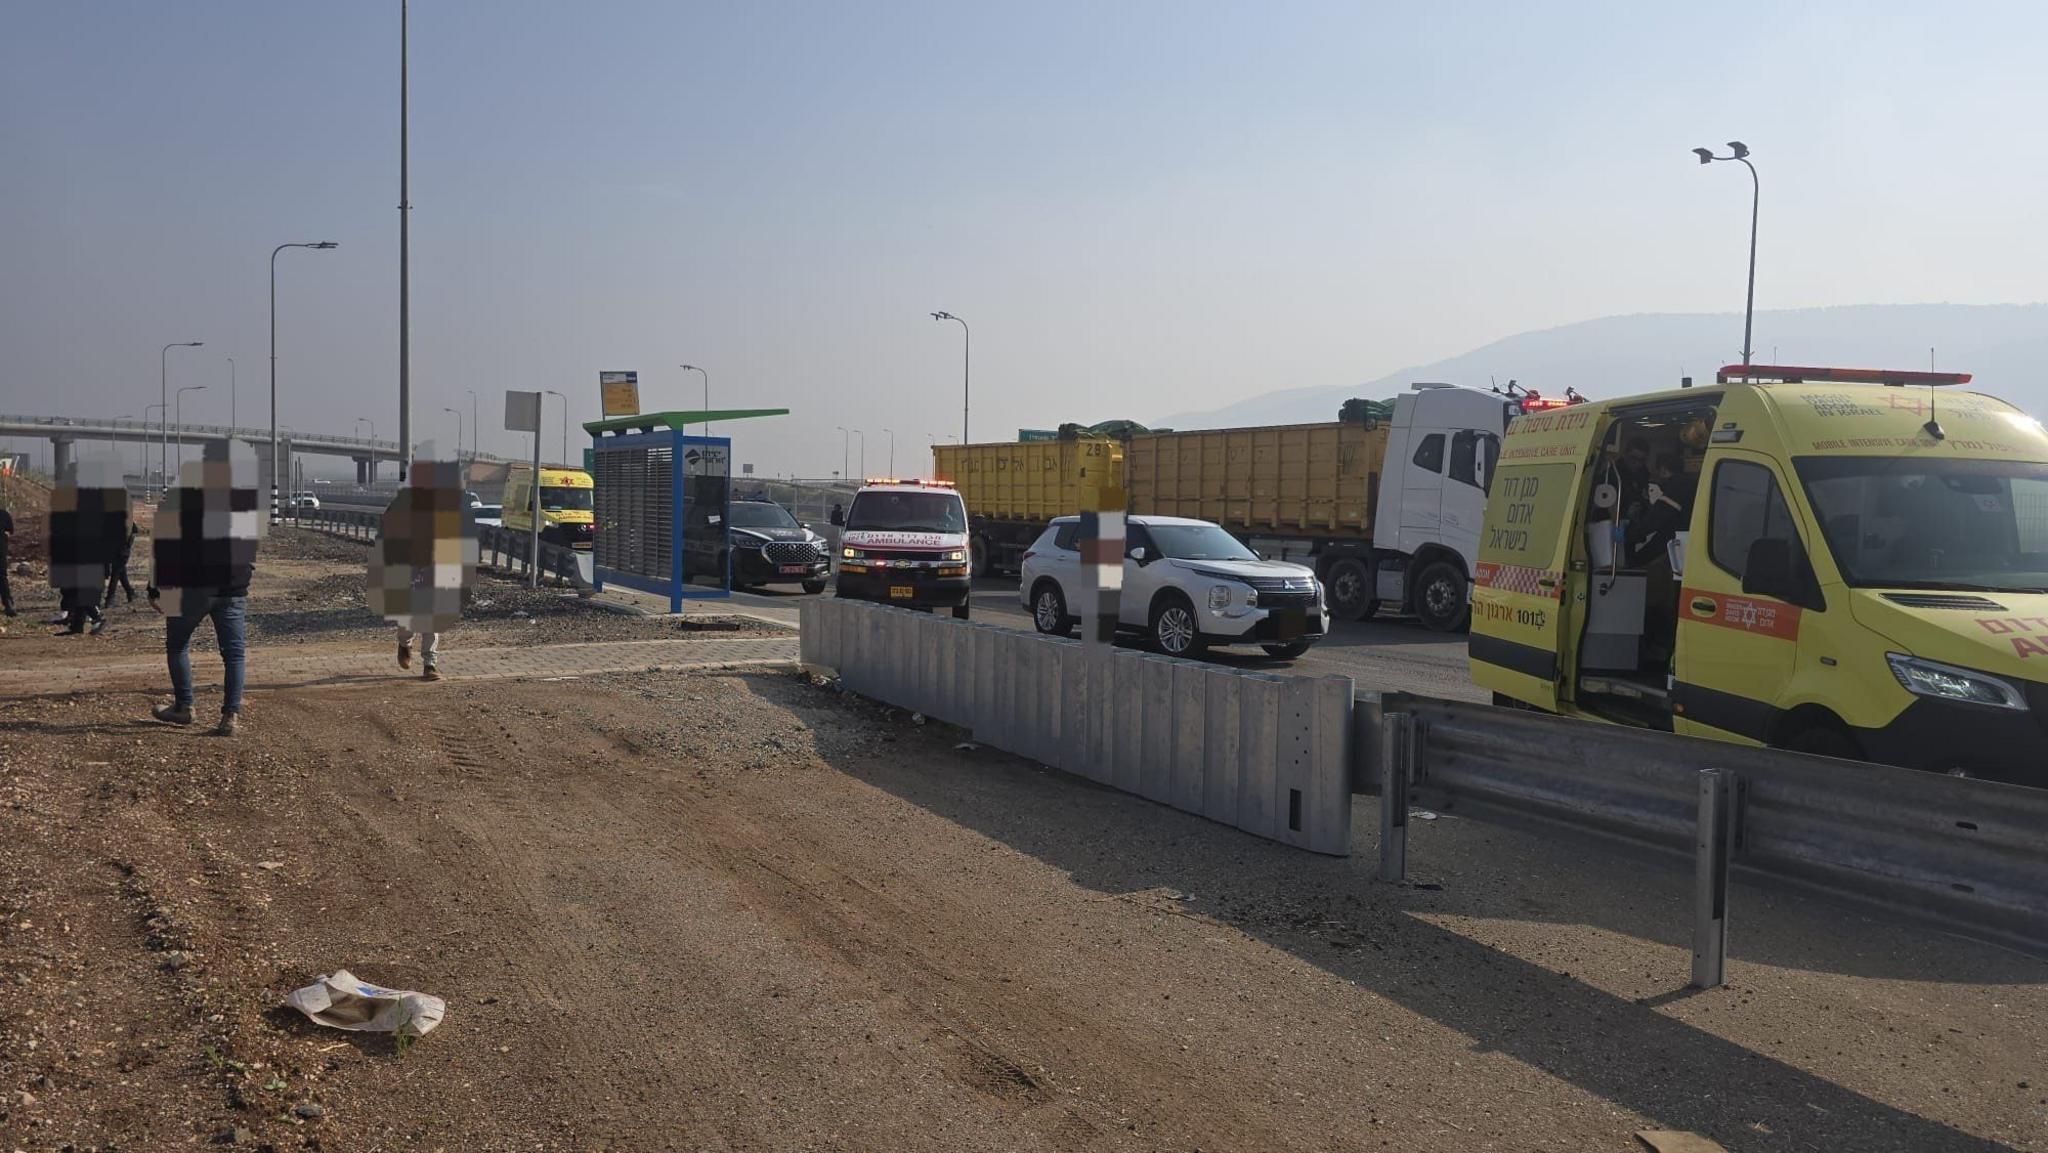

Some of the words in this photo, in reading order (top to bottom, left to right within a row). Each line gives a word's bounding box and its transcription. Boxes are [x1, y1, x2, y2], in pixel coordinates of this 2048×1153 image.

[1086, 443, 1101, 457] 28
[1540, 446, 1558, 457] CARE
[1559, 446, 1577, 456] UNIT
[1812, 440, 1848, 450] MOBILE
[1848, 438, 1895, 449] INTENSIVE
[1504, 477, 1520, 497] דוד
[1520, 477, 1539, 501] מגן
[1507, 504, 1535, 524] אדום
[1489, 525, 1528, 551] בישראל
[1487, 600, 1513, 622] ארגון
[1517, 609, 1535, 626] 101
[2010, 635, 2048, 658] A
